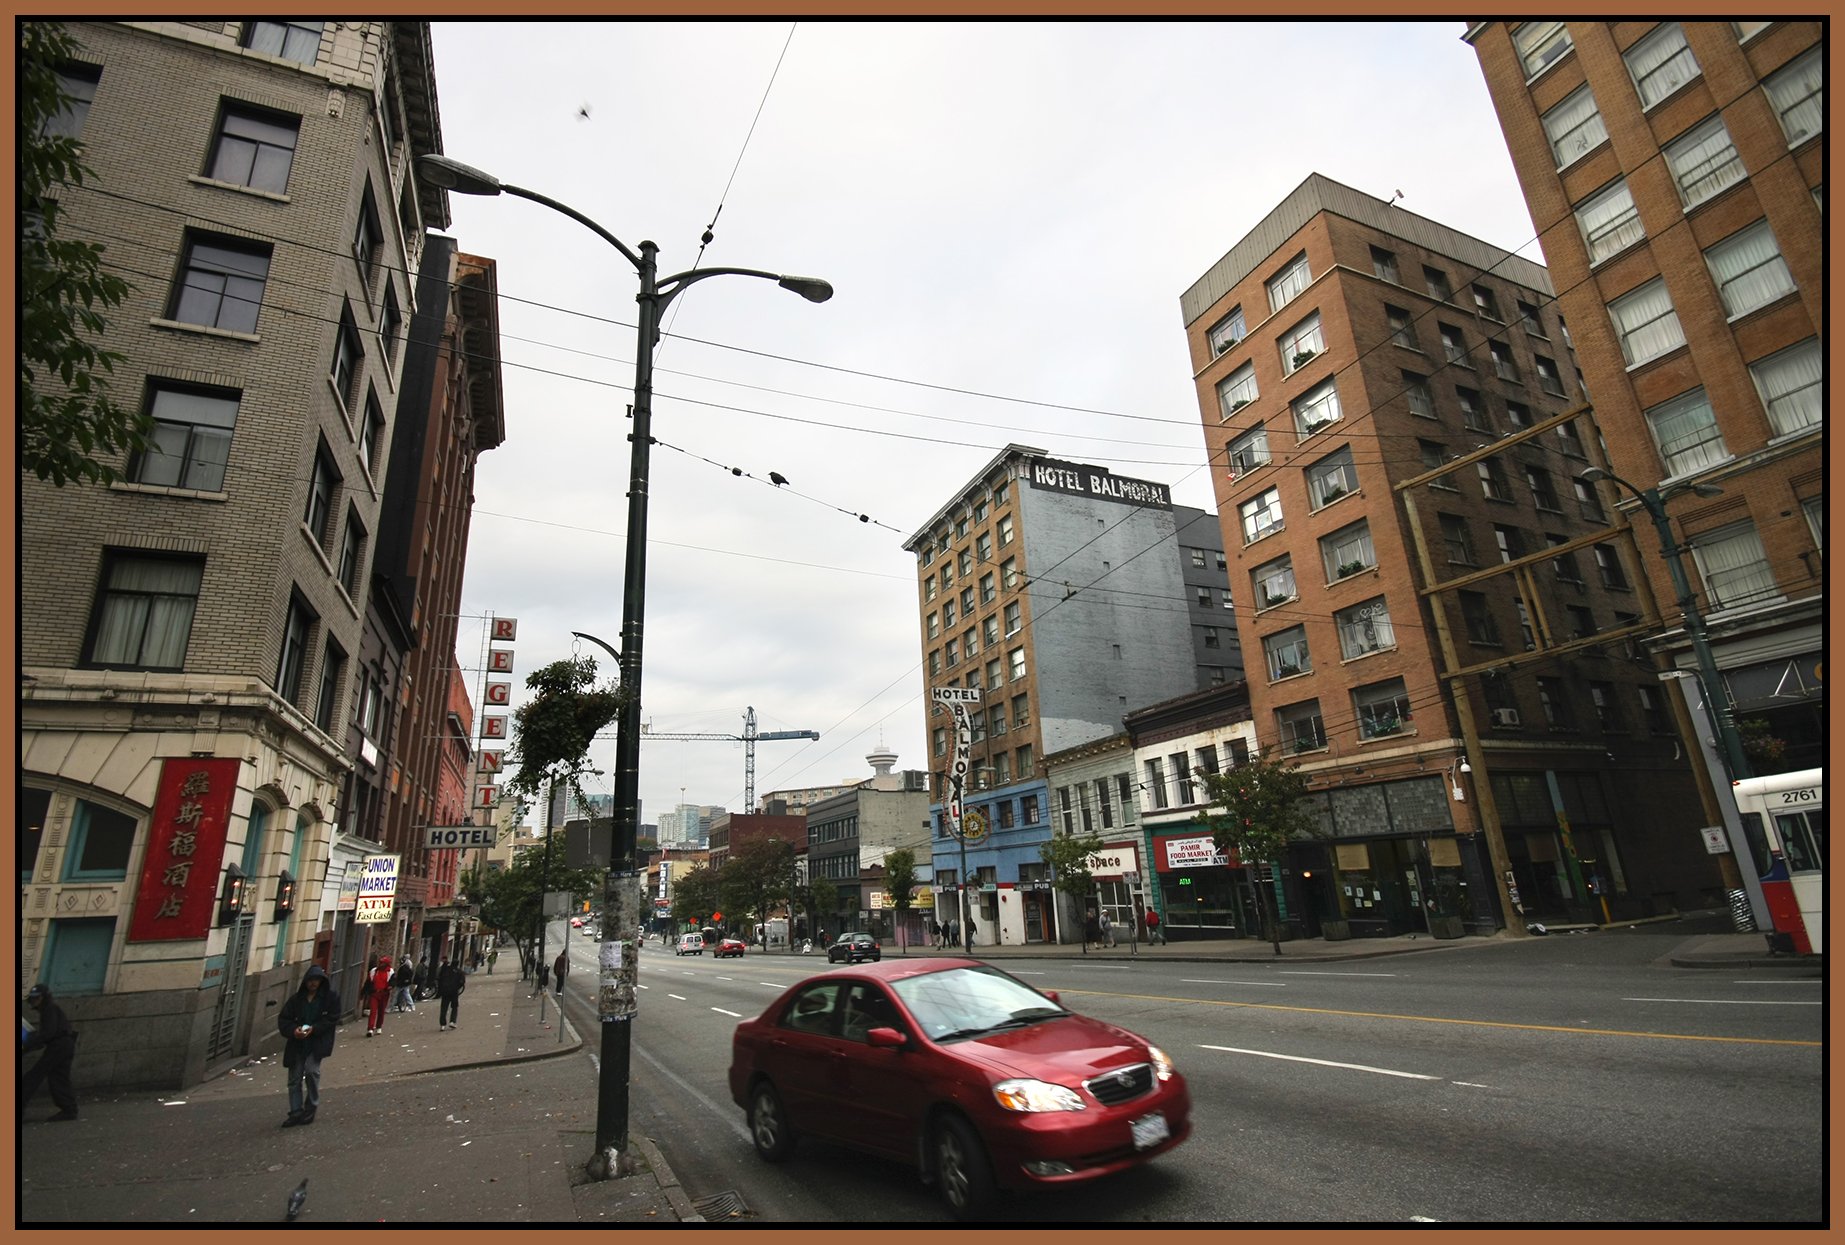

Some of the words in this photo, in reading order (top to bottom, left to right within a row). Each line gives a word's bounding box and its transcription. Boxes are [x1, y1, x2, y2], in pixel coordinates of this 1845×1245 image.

[1035, 465, 1084, 491] HOTEL
[1090, 475, 1168, 505] BALMORAL
[933, 688, 979, 701] HOTEL
[478, 620, 514, 808] REGENT
[950, 705, 970, 818] BALMOAL
[1782, 788, 1817, 804] 2761
[430, 829, 493, 845] HOTEL
[154, 771, 211, 920] 羅斯福酒店
[1180, 843, 1201, 851] PAMIR
[1170, 851, 1187, 859] FOOD
[1187, 850, 1213, 858] MARKET
[368, 858, 395, 873] UNION
[361, 876, 397, 892] MARKET
[1034, 882, 1050, 890] PUB
[358, 899, 392, 910] ATM
[356, 911, 373, 920] Fast
[373, 910, 392, 920] Cash
